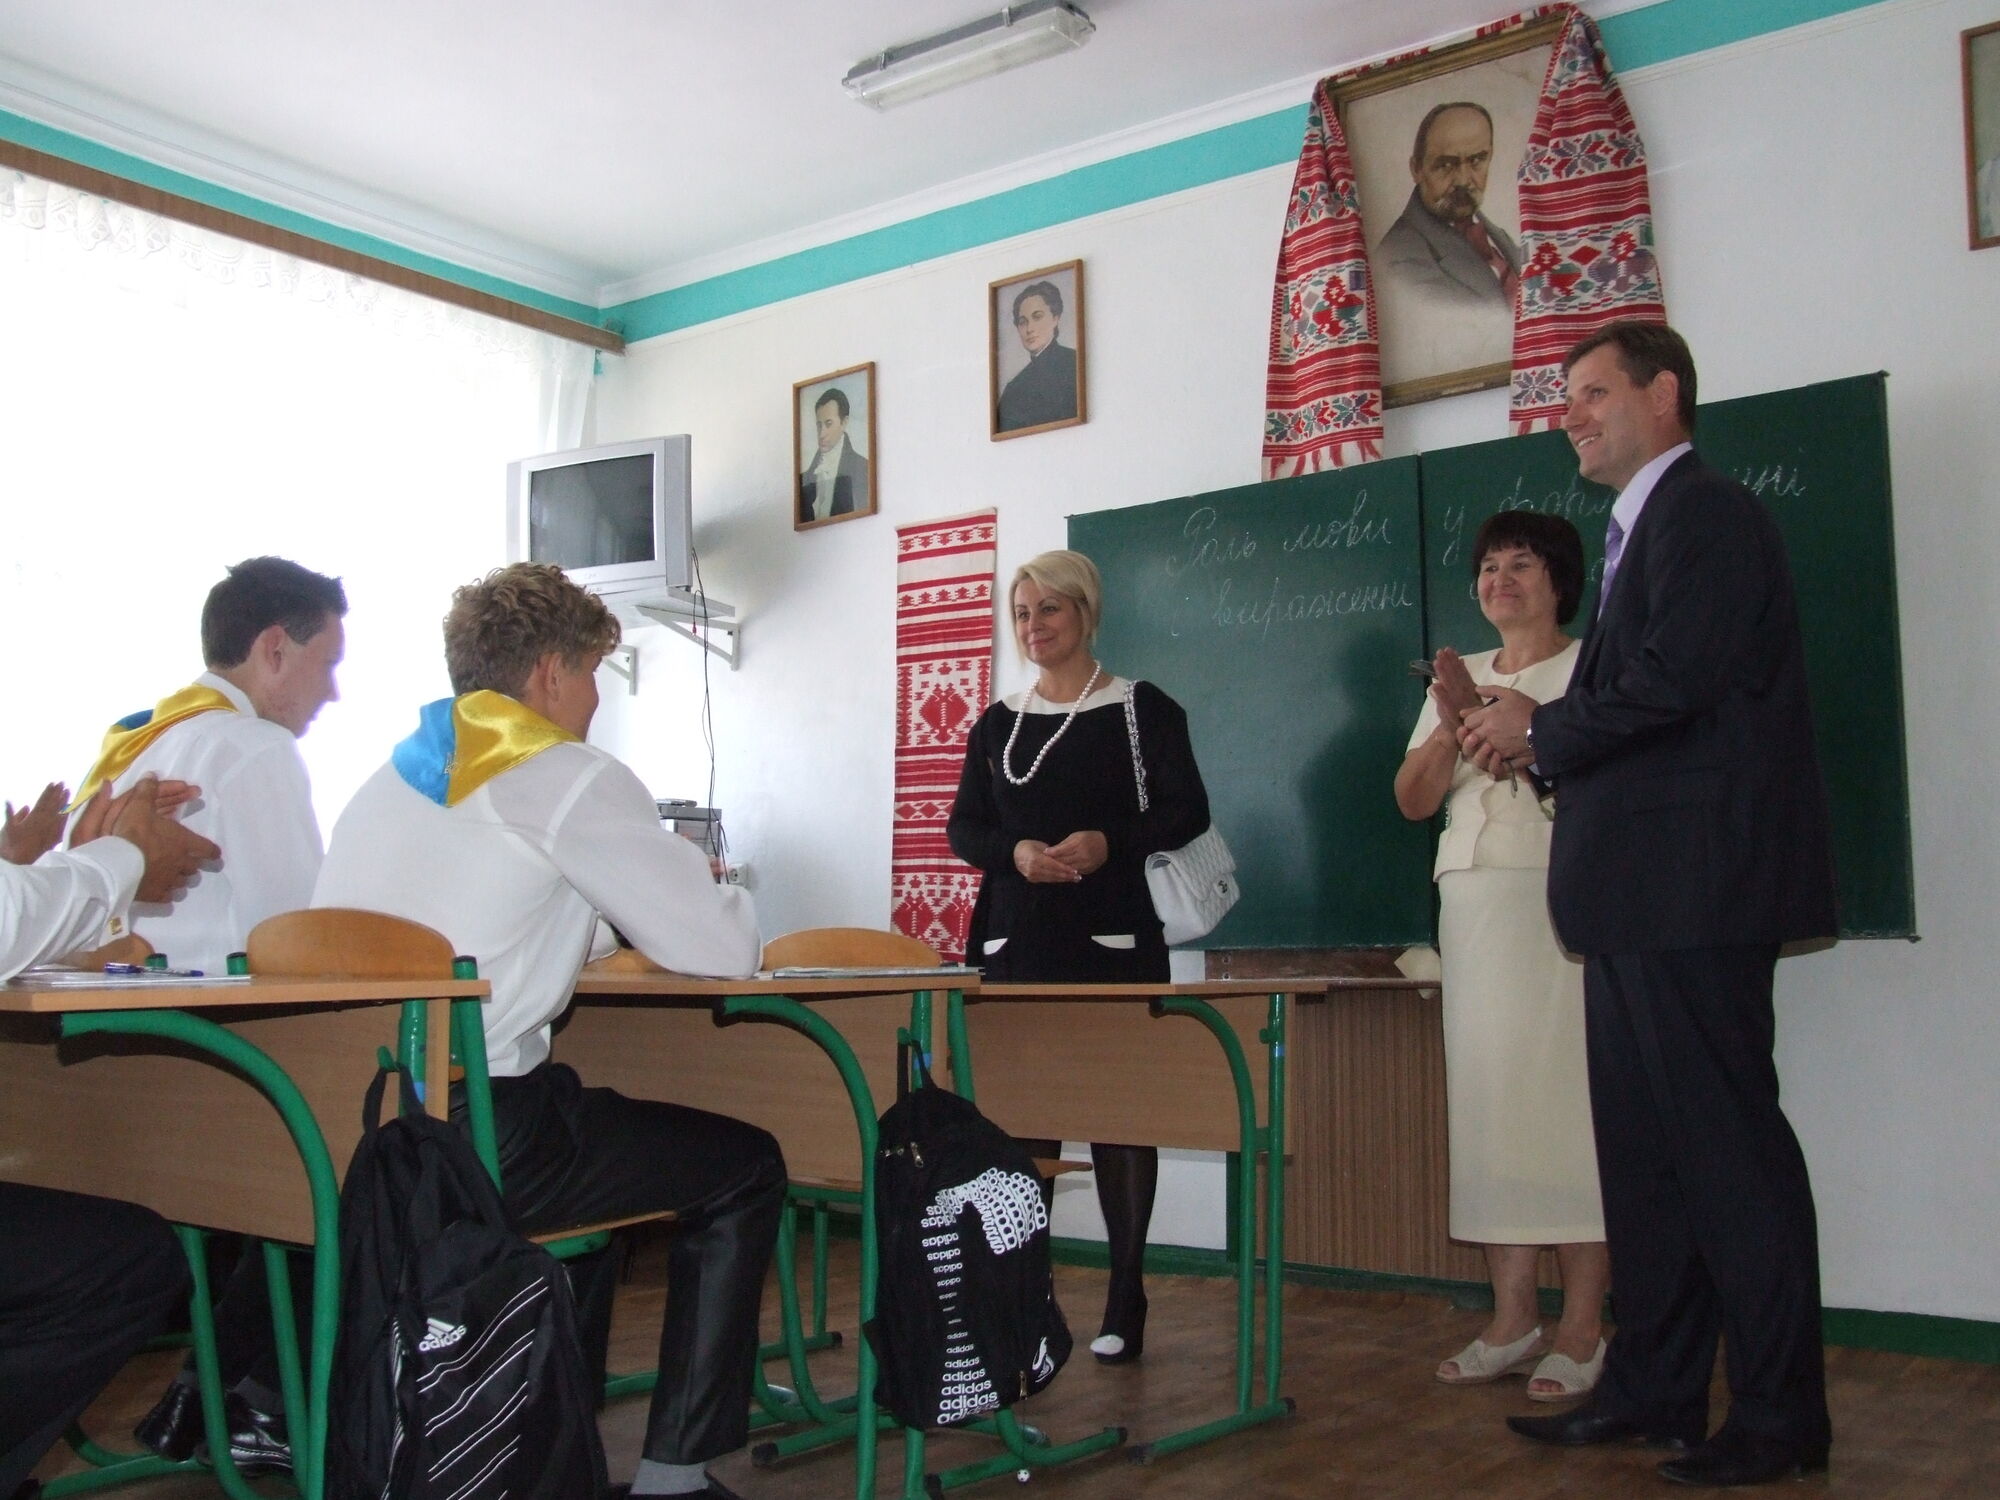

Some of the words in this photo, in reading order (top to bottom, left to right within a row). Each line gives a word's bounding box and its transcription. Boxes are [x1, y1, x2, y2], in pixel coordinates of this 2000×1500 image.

[1165, 507, 1256, 577] Роль
[1283, 489, 1392, 551] мови
[1441, 505, 1464, 567] у
[922, 1232, 959, 1247] adidas
[926, 1248, 961, 1261] adidas
[933, 1262, 963, 1274] adidas
[418, 1325, 467, 1352] adidas
[947, 1331, 968, 1340] adidas
[946, 1344, 974, 1354] adidas
[944, 1356, 980, 1368] adidas
[942, 1368, 986, 1382] adidas
[941, 1379, 992, 1396] adidas
[939, 1391, 998, 1411] adidas
